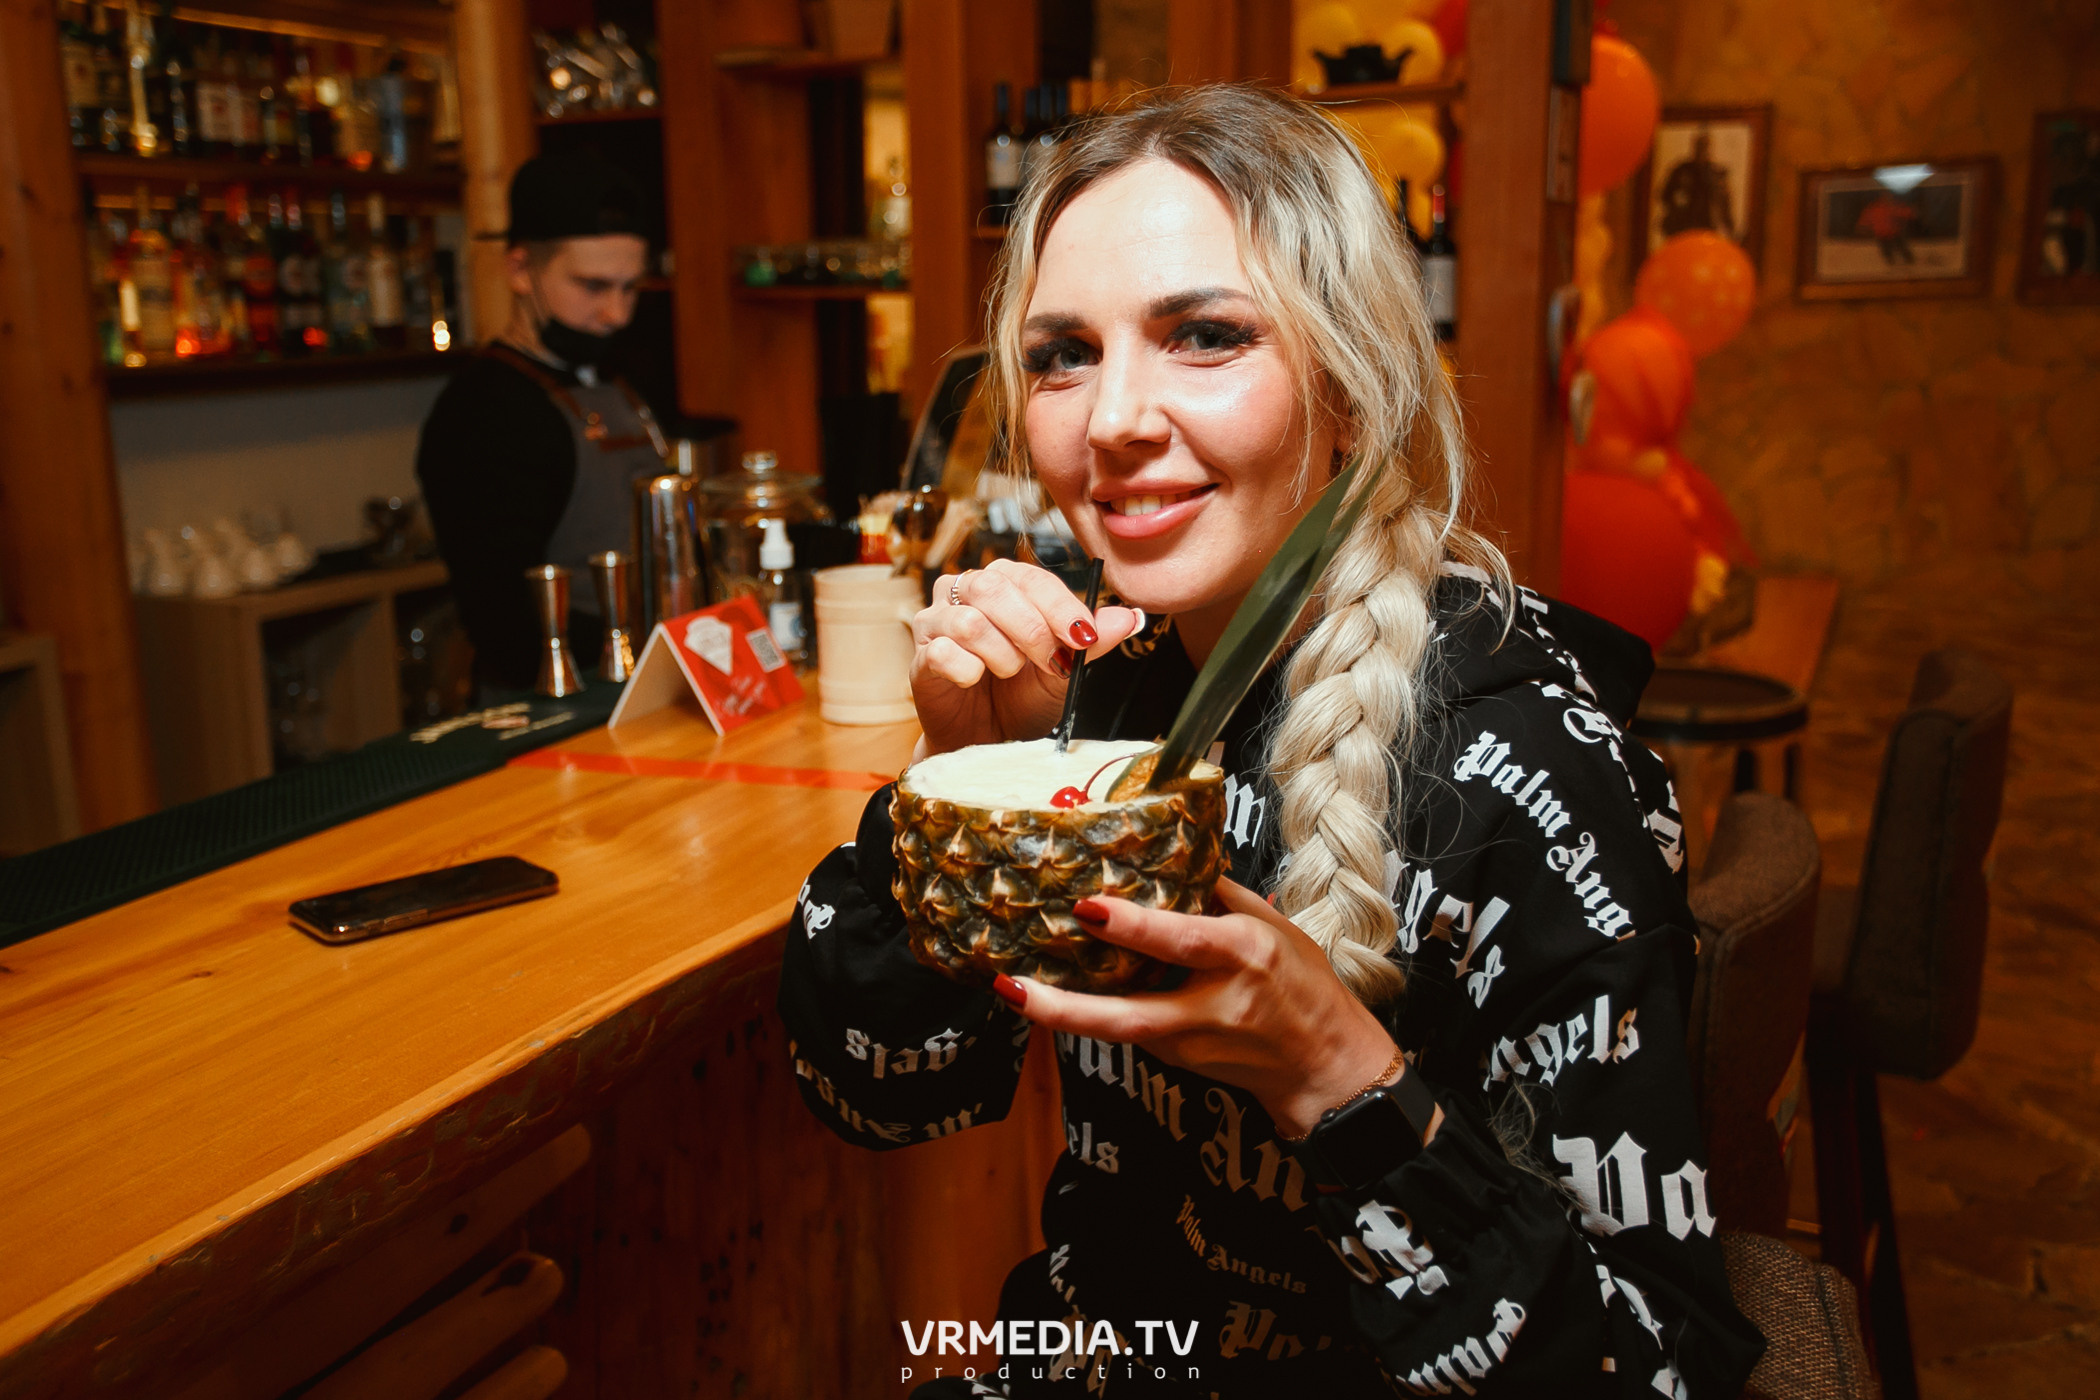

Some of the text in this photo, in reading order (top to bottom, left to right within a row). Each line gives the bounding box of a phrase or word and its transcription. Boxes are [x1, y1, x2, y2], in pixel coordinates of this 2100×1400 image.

[1453, 730, 1572, 838] Palm
[1545, 831, 1638, 942] Ang
[1482, 994, 1641, 1092] ngels
[1175, 1194, 1307, 1295] Palm Angels
